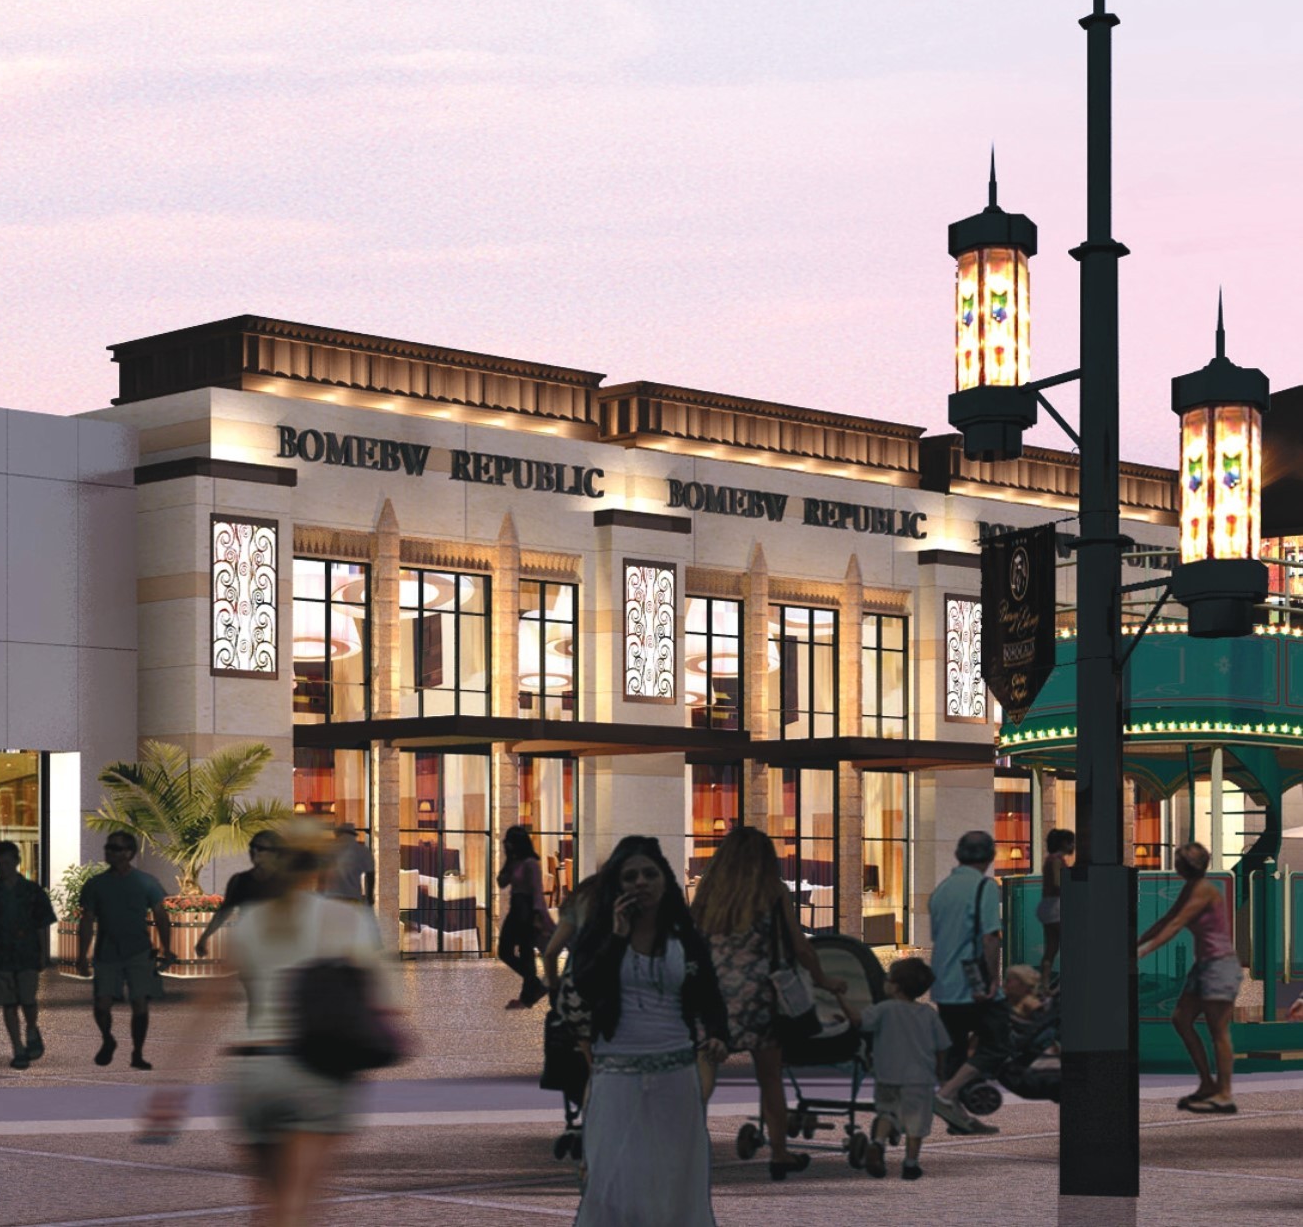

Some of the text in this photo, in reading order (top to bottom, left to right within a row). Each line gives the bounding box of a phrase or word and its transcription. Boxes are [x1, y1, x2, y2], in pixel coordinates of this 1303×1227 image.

[276, 424, 605, 499] BOMEBW REPUBLIC
[666, 478, 927, 540] BOMEBW REPUBLIC
